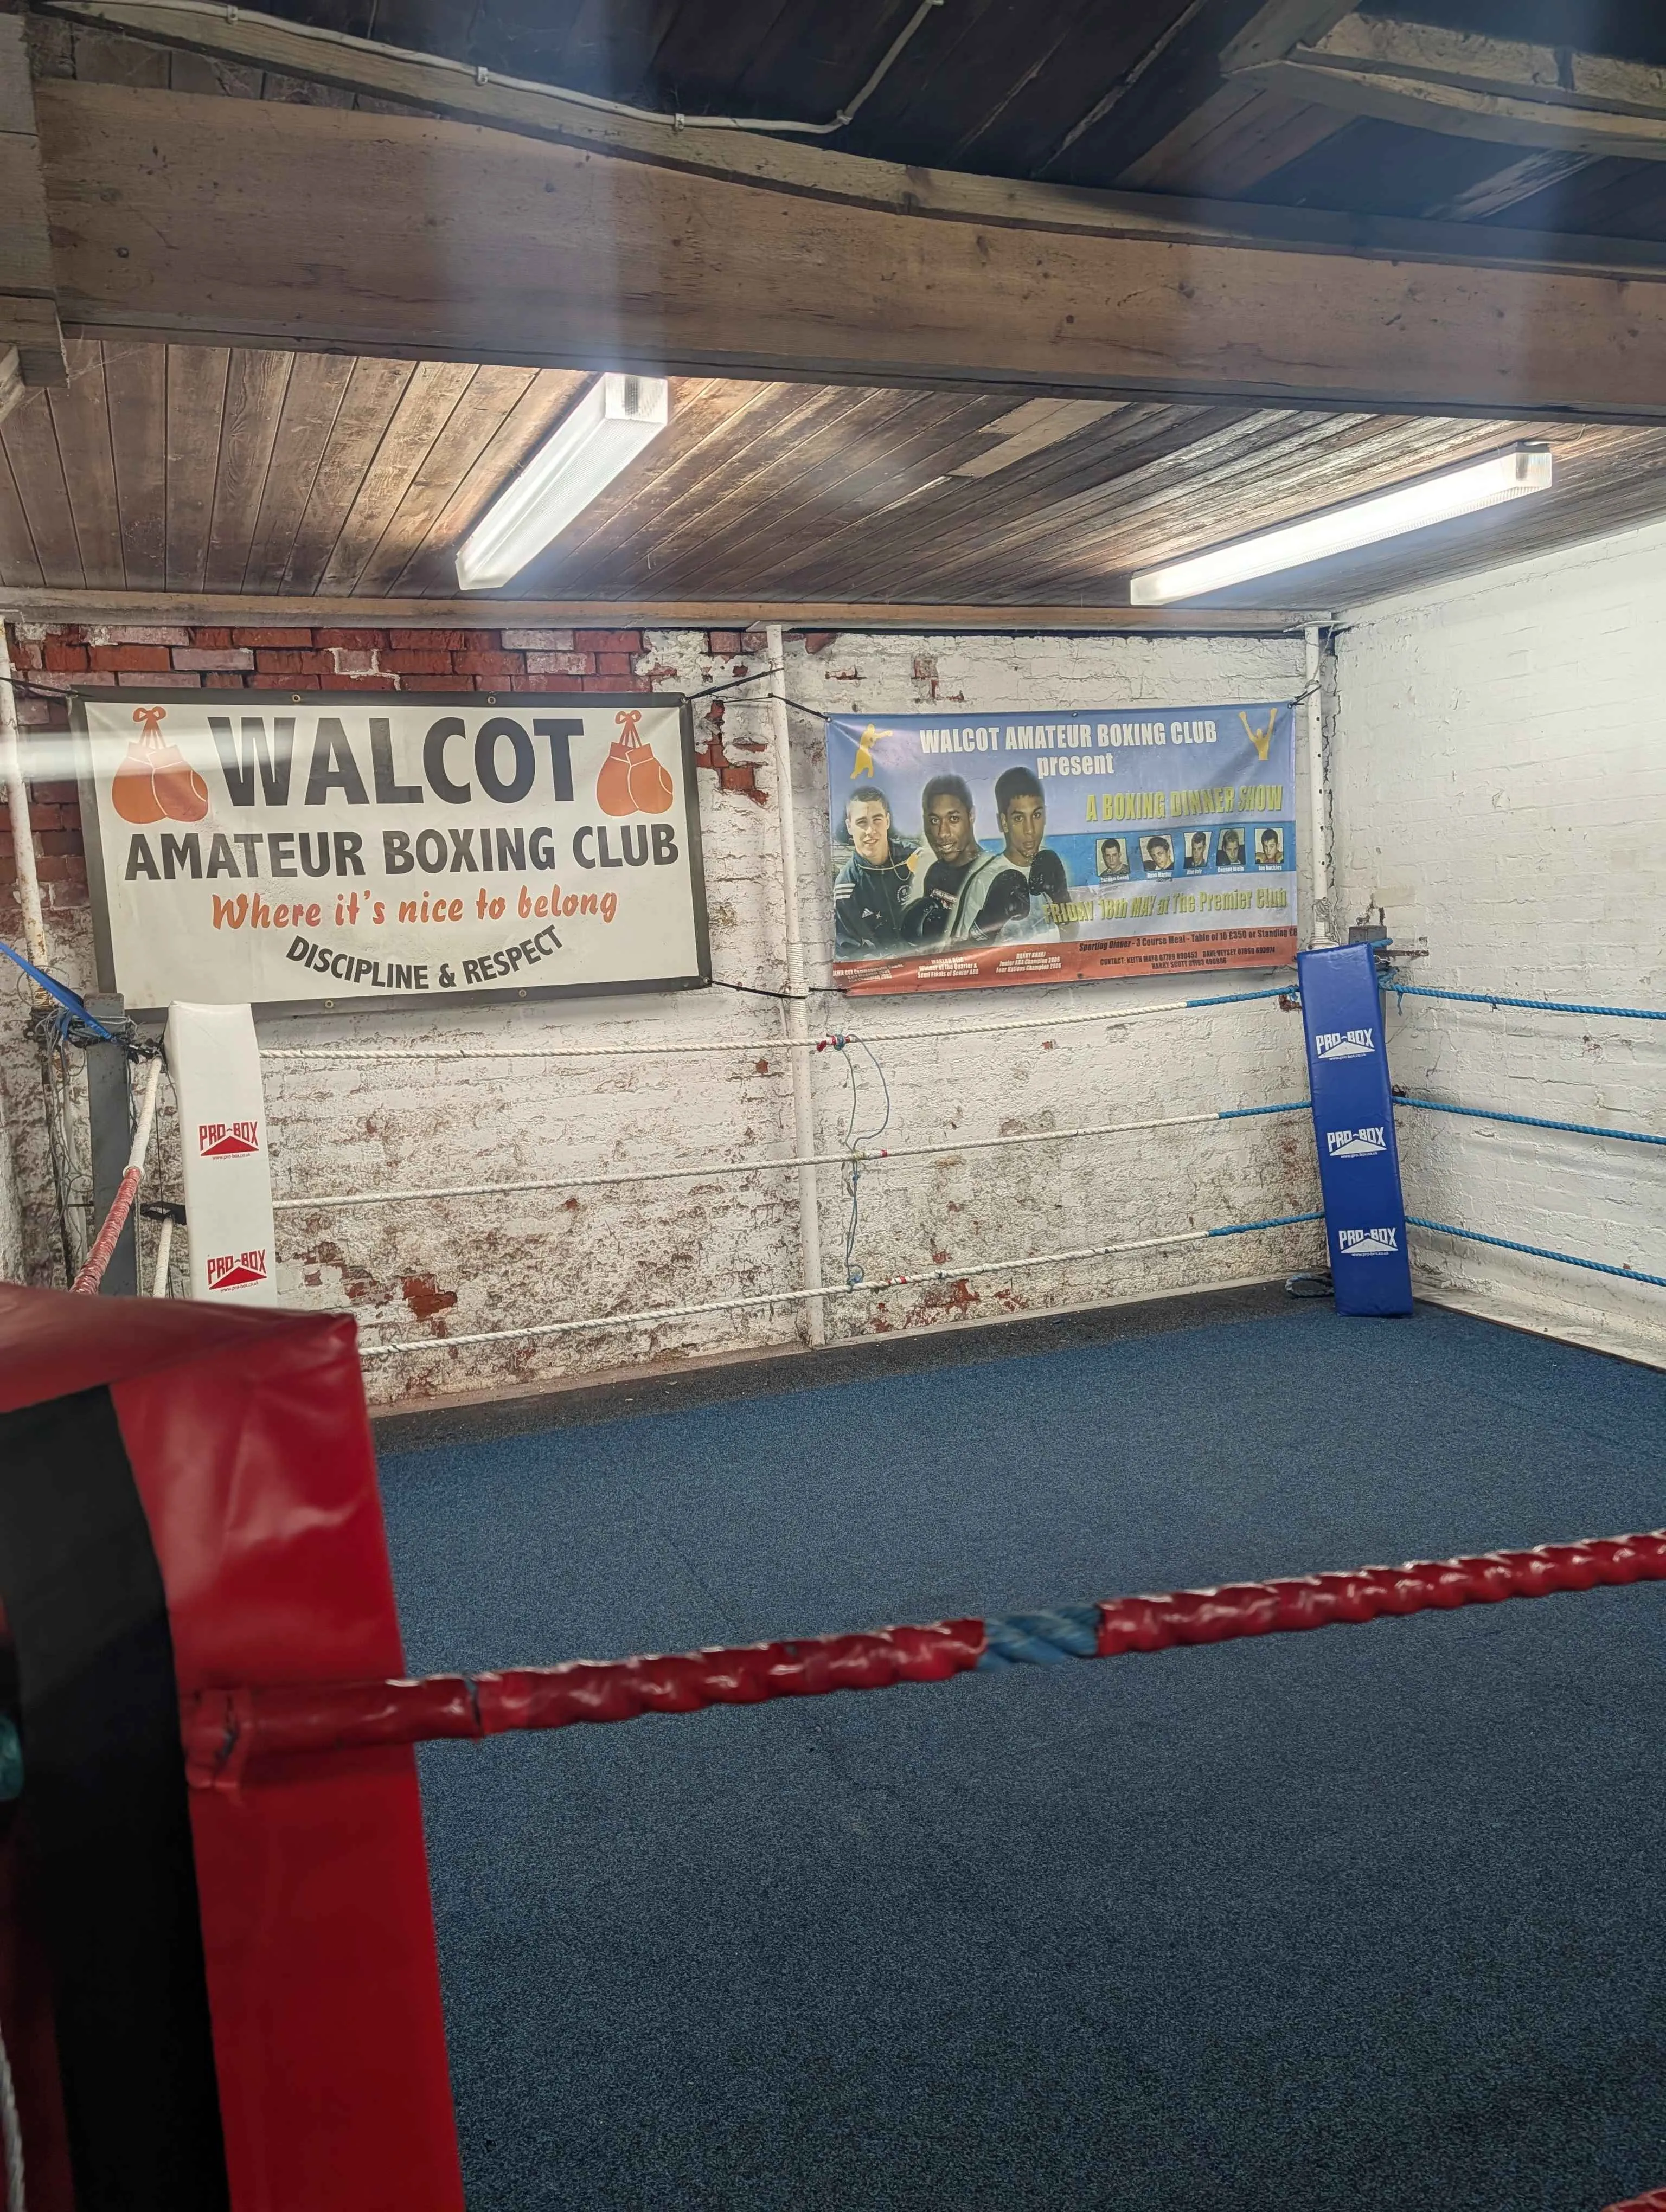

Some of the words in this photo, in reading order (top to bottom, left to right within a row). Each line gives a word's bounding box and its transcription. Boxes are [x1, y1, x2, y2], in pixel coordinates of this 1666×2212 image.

[920, 726, 999, 753] WALCOT
[1005, 725, 1092, 750] AMATEUR
[1098, 723, 1165, 747] BOXING
[1171, 721, 1217, 743] CLUB
[208, 716, 584, 807] WALCOT
[1037, 753, 1114, 779] present
[1086, 795, 1097, 821] A
[1102, 791, 1165, 820] BOXING
[1170, 787, 1235, 817] DINNER
[1238, 785, 1283, 811] SHOW
[125, 830, 366, 882] AMATEUR
[382, 826, 555, 875] BOXING
[573, 824, 679, 869] CLUB
[212, 893, 321, 929] Where
[335, 890, 385, 926] it's
[399, 891, 463, 923] nice
[476, 887, 505, 920] to
[518, 884, 617, 923] belong
[1042, 901, 1094, 923] FRIDAY
[1098, 898, 1128, 919] 18th
[1130, 896, 1156, 918] MAY
[1157, 896, 1170, 915] at
[1172, 893, 1195, 914] The
[1199, 889, 1252, 912] Premier
[1255, 888, 1288, 908] Club
[286, 935, 429, 989] DISCIPLINE
[438, 963, 457, 988] &
[462, 924, 562, 984] RESPECT
[1079, 941, 1107, 951] Sporting
[1109, 940, 1131, 949] Dinner
[1136, 938, 1140, 947] 3
[1142, 937, 1167, 947] Course
[1168, 935, 1186, 944] Meal
[1191, 933, 1209, 942] Table
[1211, 932, 1218, 941] of
[1220, 931, 1227, 940] 10
[1229, 930, 1246, 939] £350
[1257, 928, 1287, 938] Standing
[1100, 957, 1126, 965] CONTACT:
[1127, 956, 1142, 964] KEITH
[1170, 960, 1187, 968] SCOTT
